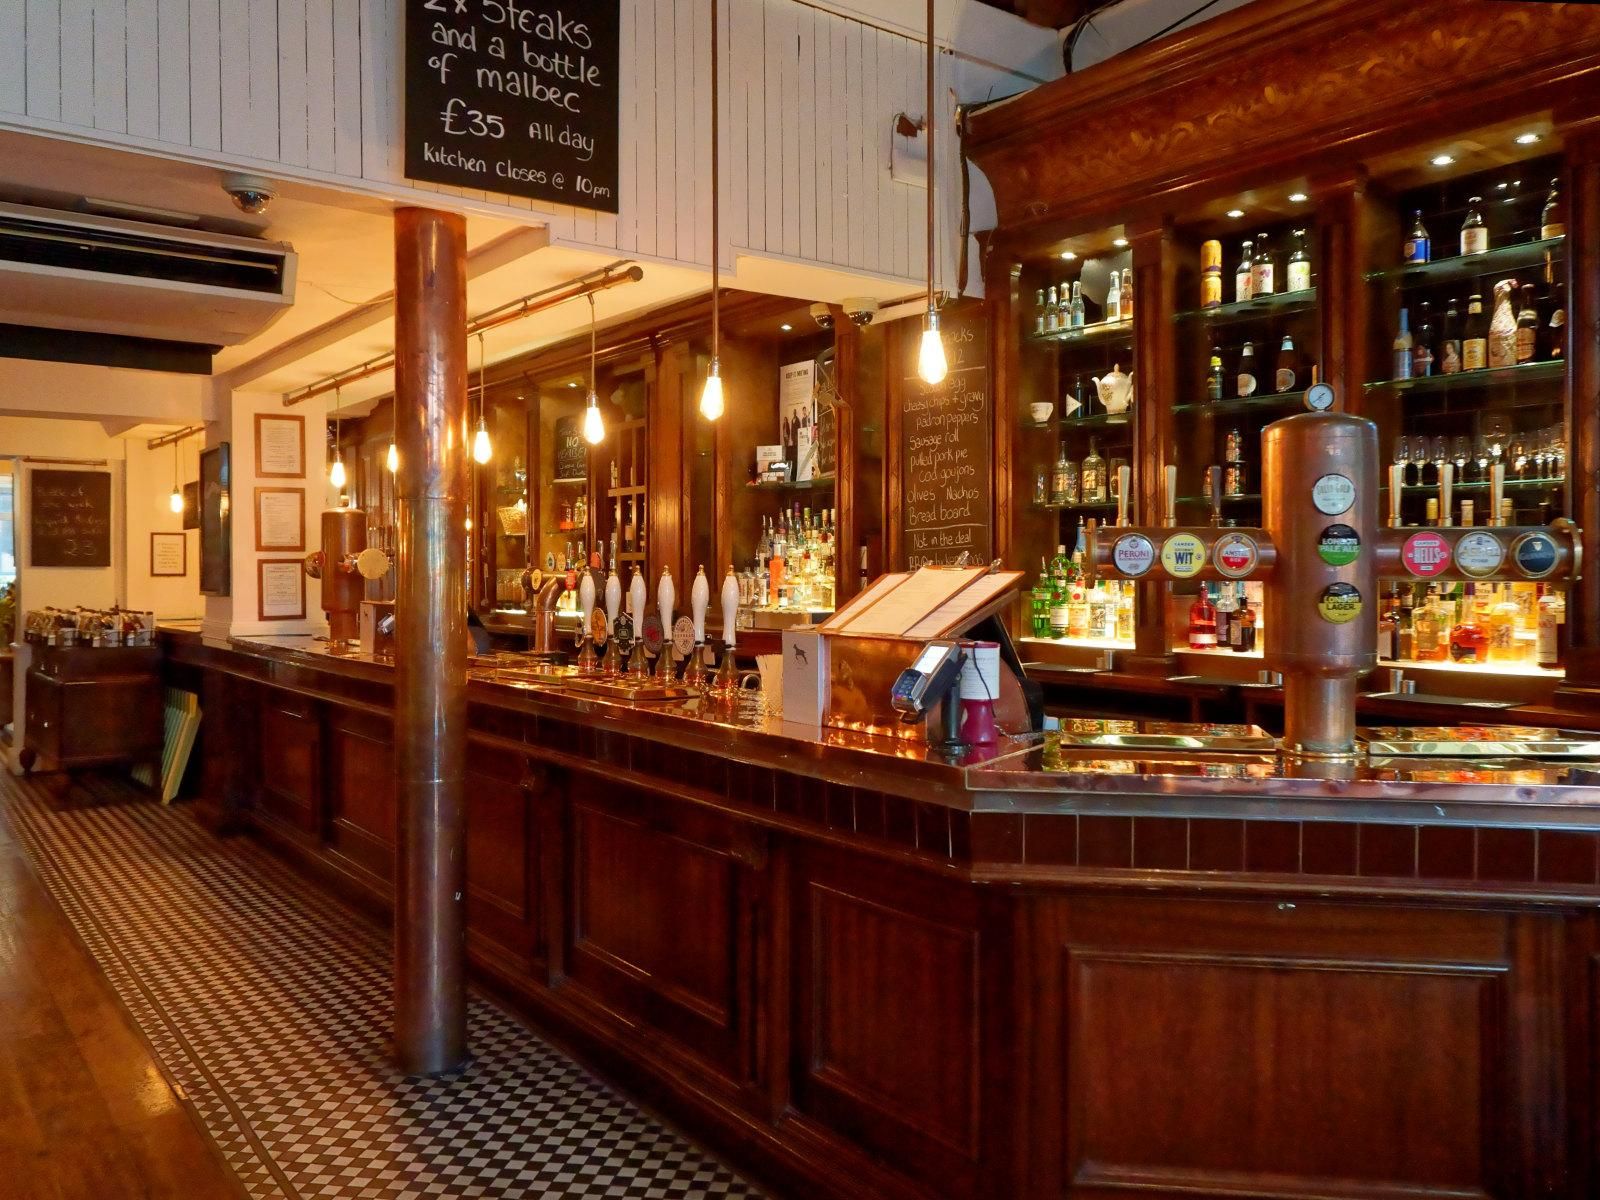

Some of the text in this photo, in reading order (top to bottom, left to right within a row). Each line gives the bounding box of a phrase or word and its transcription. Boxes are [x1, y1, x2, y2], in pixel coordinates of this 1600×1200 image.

[482, 0, 592, 49] Steaks
[431, 22, 600, 86] and a bottle
[428, 53, 580, 113] of malbec
[440, 98, 594, 161] £35 All day
[552, 172, 565, 189] @
[945, 428, 959, 443] roll
[909, 501, 971, 525] Bread board
[955, 528, 971, 544] deal
[1118, 550, 1150, 558] PERONI
[1414, 547, 1440, 563] HELLS
